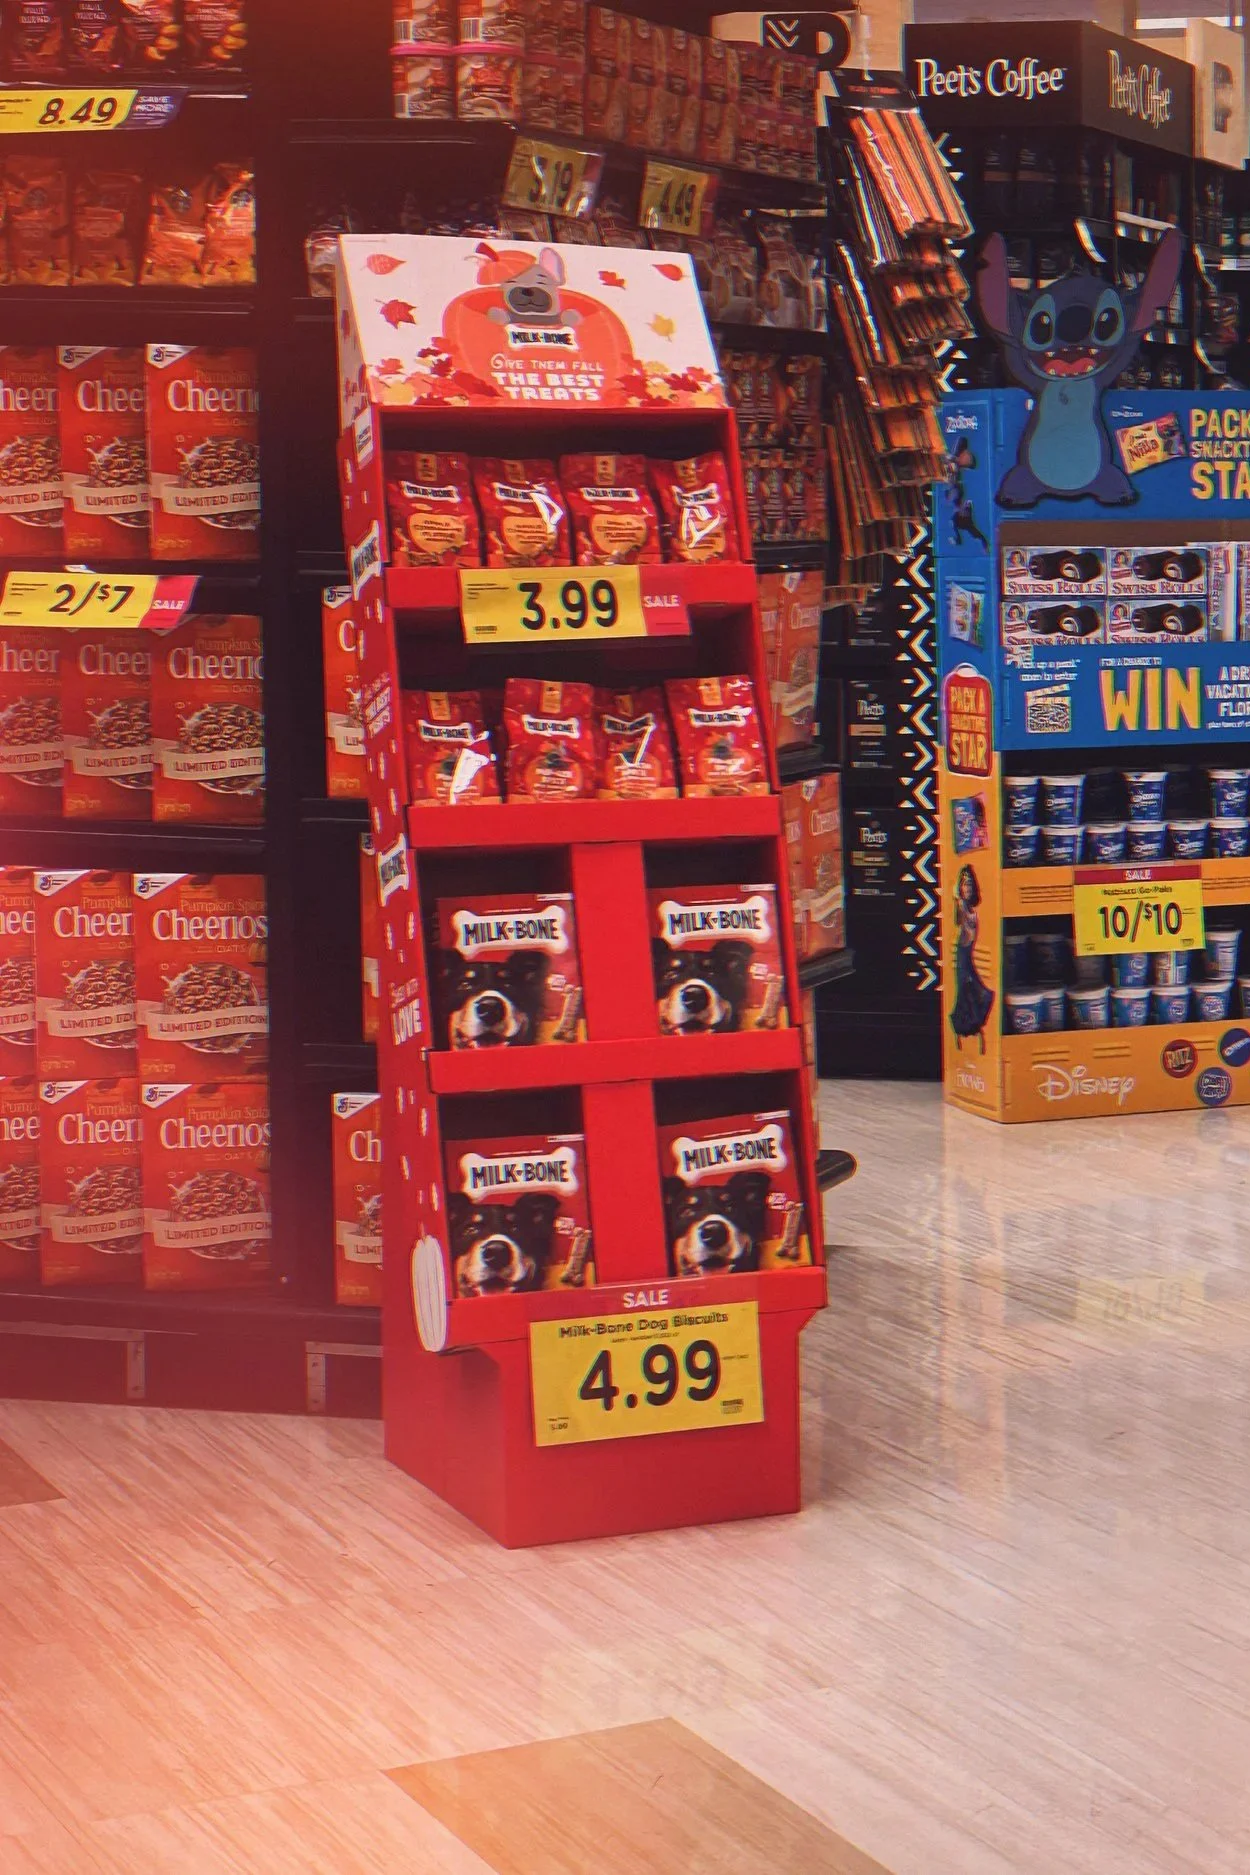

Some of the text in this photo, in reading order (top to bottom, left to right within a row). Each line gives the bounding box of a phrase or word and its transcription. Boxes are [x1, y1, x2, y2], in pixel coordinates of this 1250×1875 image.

[915, 56, 1064, 100] Peet's Coffee
[1108, 49, 1171, 130] Peet's Coffee
[38, 97, 118, 125] 8.49
[491, 372, 604, 387] THE BEST
[572, 361, 604, 372] FALL
[504, 386, 600, 400] TREATS
[49, 581, 135, 616] 2/$7
[643, 594, 680, 608] SALE
[1007, 582, 1104, 594] SWISS ROLLS
[1111, 582, 1204, 594] SWISS ROLLS
[150, 599, 185, 611] SALE
[519, 580, 618, 632] 3.99
[1218, 666, 1229, 680] A
[1100, 667, 1202, 731] WIN
[950, 732, 988, 769] STAR
[1125, 869, 1152, 881] SALE
[152, 909, 268, 940] Cheerios
[464, 917, 559, 947] MILK-BONE
[669, 908, 762, 936] MILK-BONE
[1098, 900, 1183, 943] 10/$10
[392, 998, 422, 1046] LOVE
[160, 1117, 271, 1149] Cheerios
[682, 1137, 777, 1173] MILK-BONE
[472, 1160, 569, 1190] MILK-BONE
[167, 1227, 218, 1240] LIMITED
[623, 1289, 669, 1309] SALE
[560, 1321, 633, 1339] Milk-Bone
[637, 1318, 669, 1331] Dog
[673, 1311, 729, 1328] Biscuits
[578, 1339, 722, 1412] 4.99
